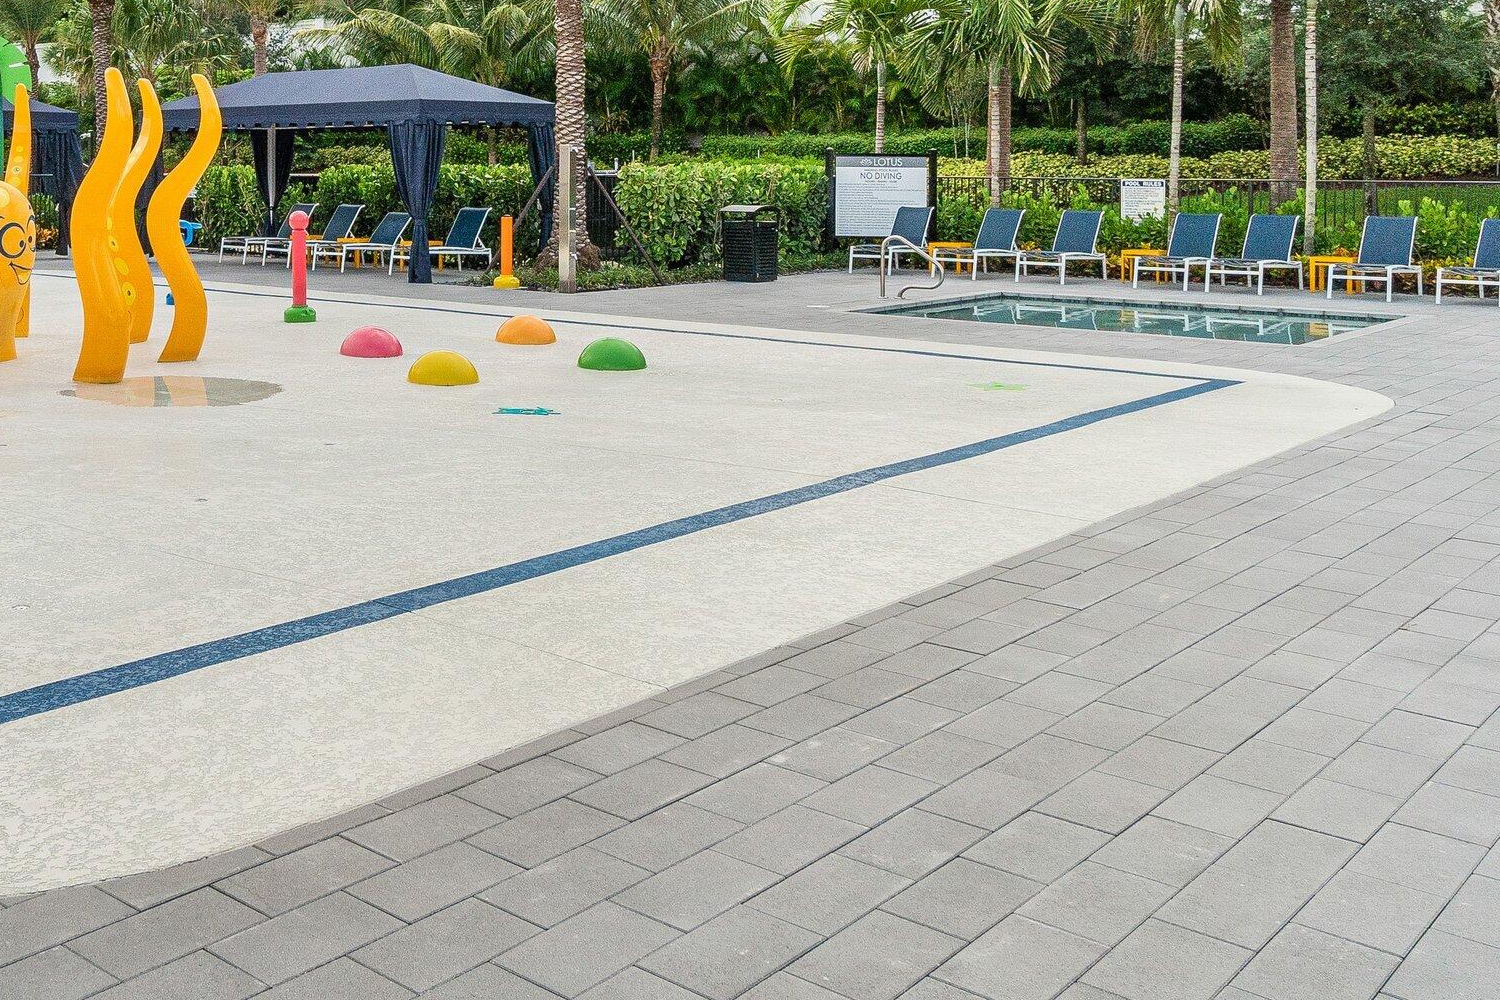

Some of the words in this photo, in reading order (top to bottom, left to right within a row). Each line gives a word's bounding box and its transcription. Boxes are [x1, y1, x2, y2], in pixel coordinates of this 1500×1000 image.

[873, 157, 903, 166] LOTUS
[860, 172, 873, 180] NO
[874, 172, 902, 180] DIVING
